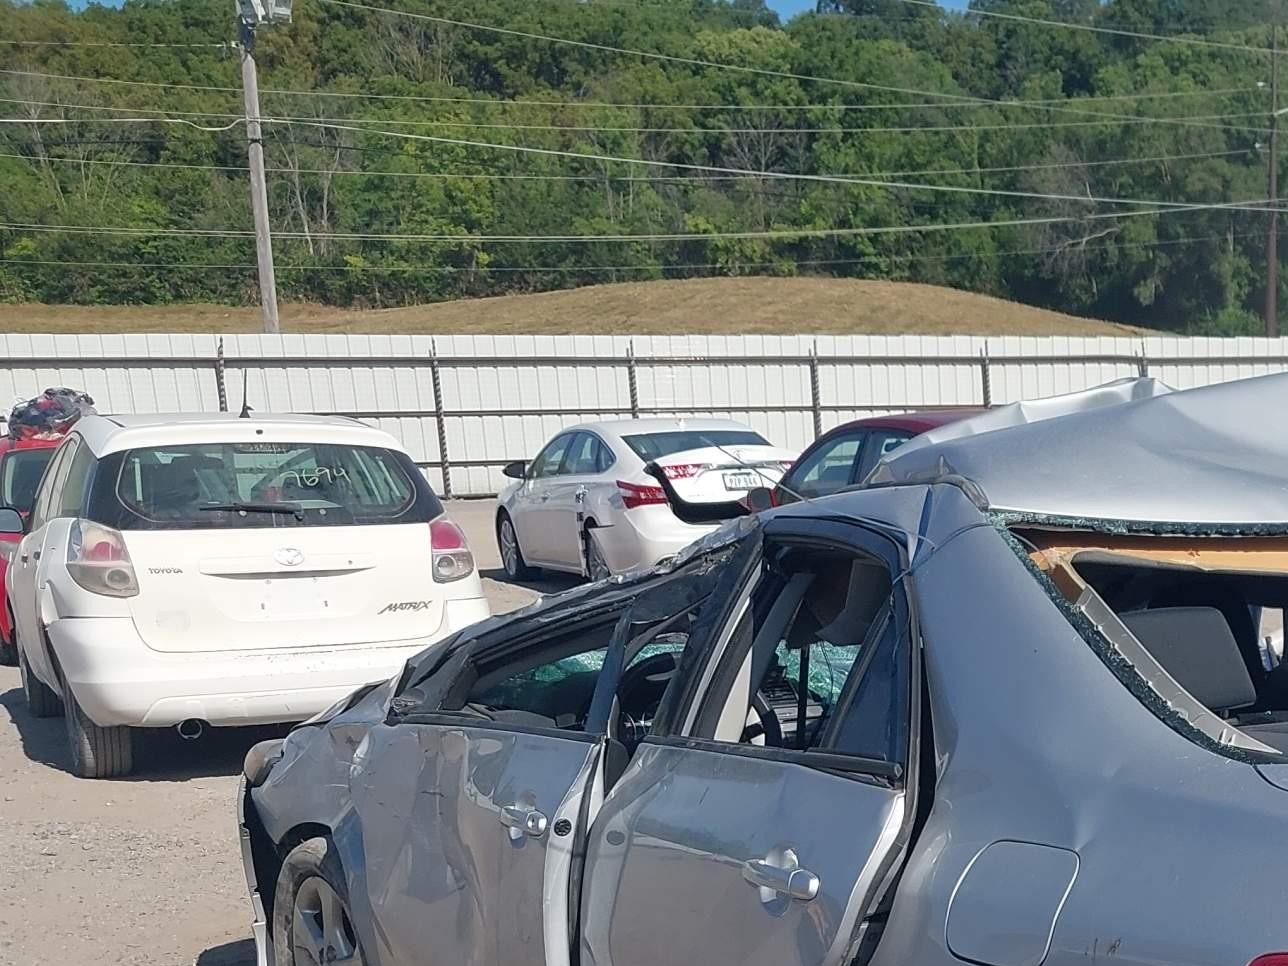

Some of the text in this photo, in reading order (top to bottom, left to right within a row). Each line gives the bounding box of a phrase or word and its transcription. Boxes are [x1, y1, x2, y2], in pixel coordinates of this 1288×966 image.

[279, 466, 353, 489] 7694
[148, 567, 184, 575] TOYOTA
[376, 599, 434, 615] MATRIX
